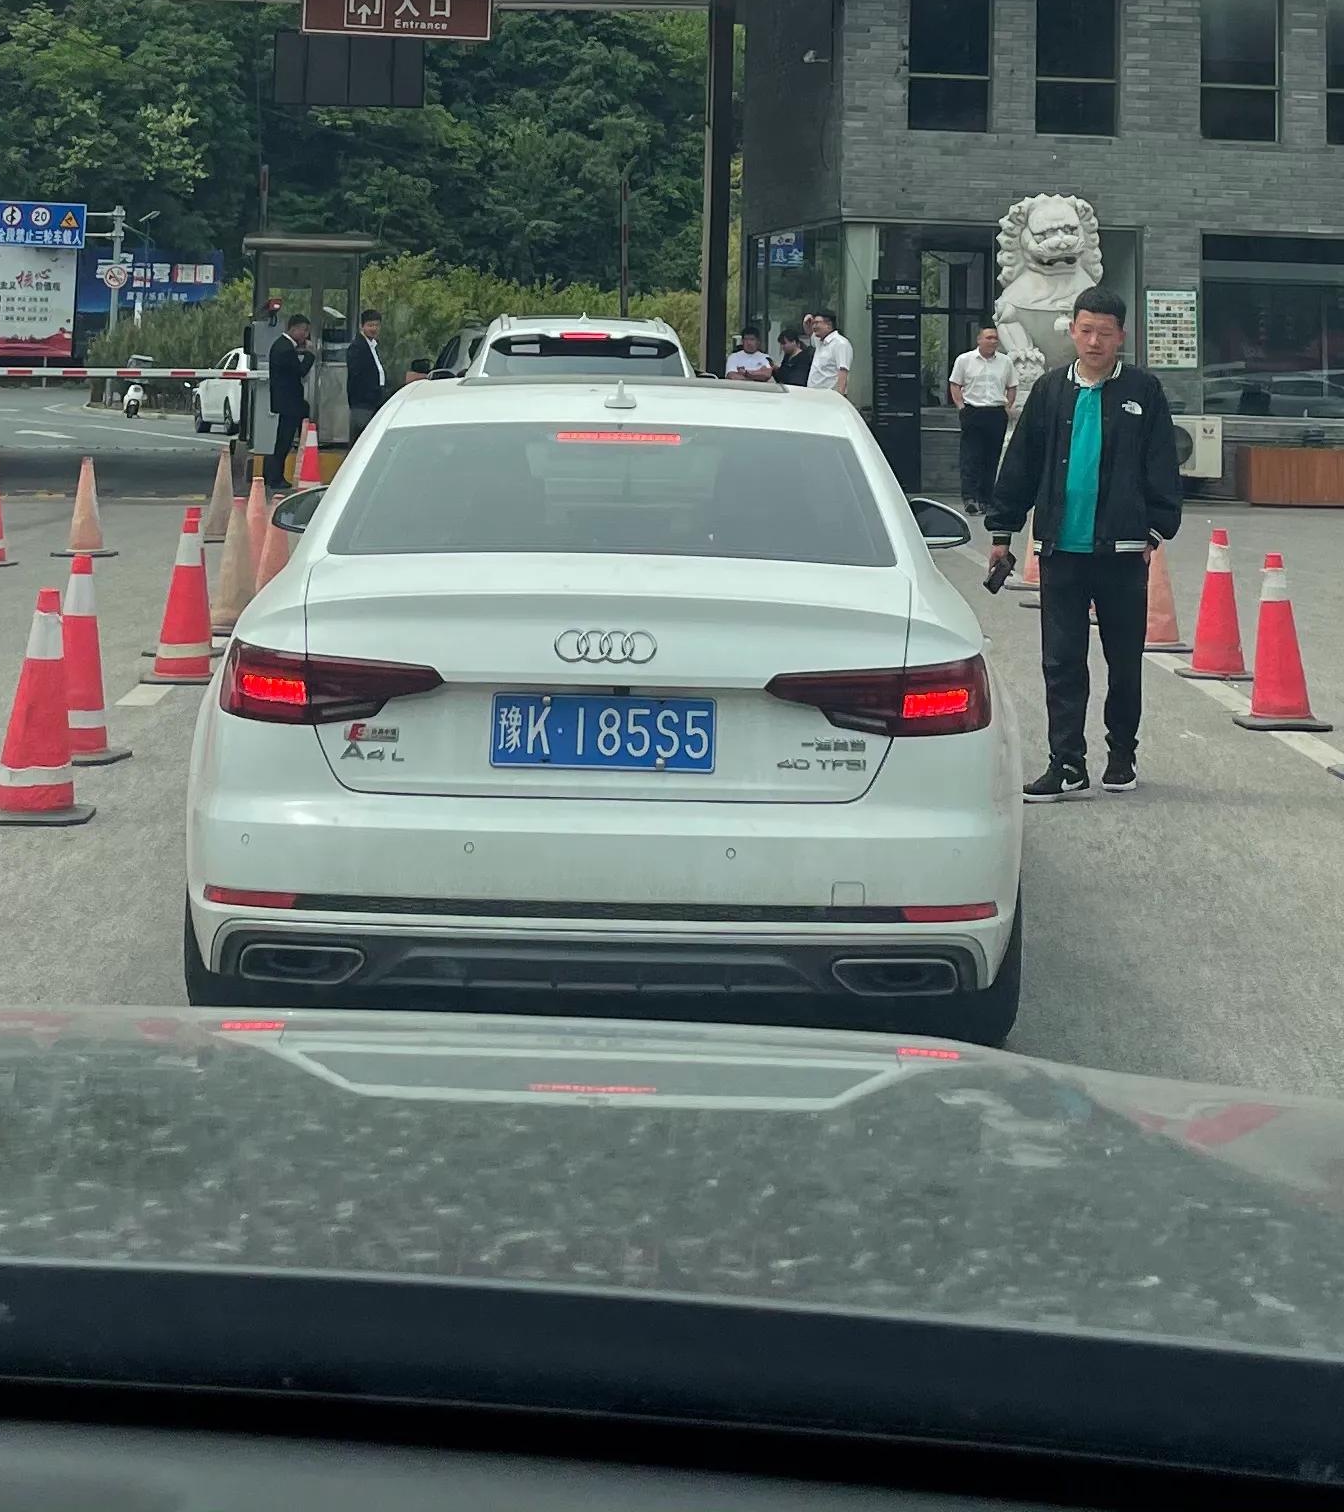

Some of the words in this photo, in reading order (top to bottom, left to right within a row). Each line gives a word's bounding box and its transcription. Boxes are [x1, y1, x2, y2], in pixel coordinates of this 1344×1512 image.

[393, 18, 448, 31] Entrance
[34, 210, 48, 222] 20
[816, 758, 867, 771] TFSI
